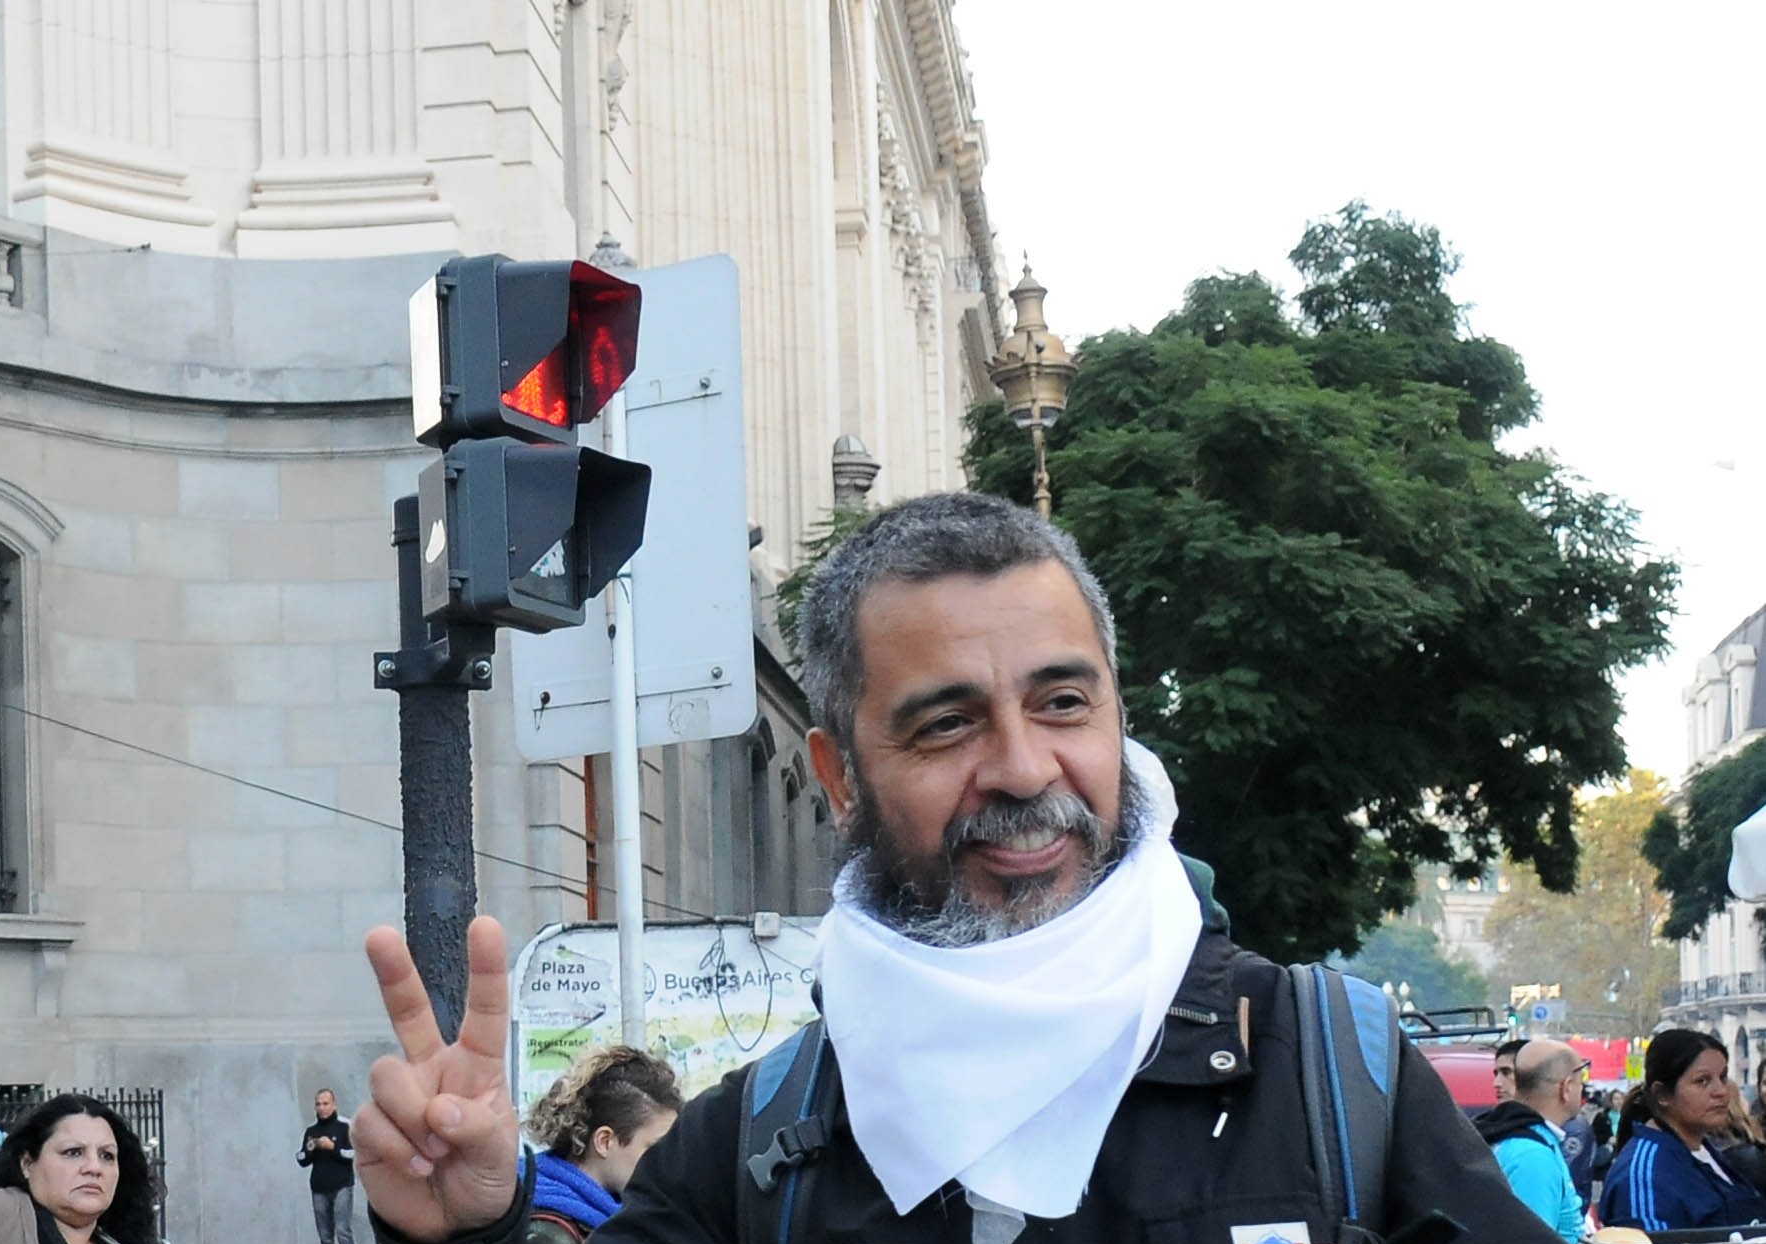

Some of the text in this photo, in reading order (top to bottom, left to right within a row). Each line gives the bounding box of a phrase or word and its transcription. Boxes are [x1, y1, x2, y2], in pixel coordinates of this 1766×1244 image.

[541, 961, 585, 975] Plaza
[742, 969, 794, 987] Aires
[531, 979, 601, 995] de Mayo
